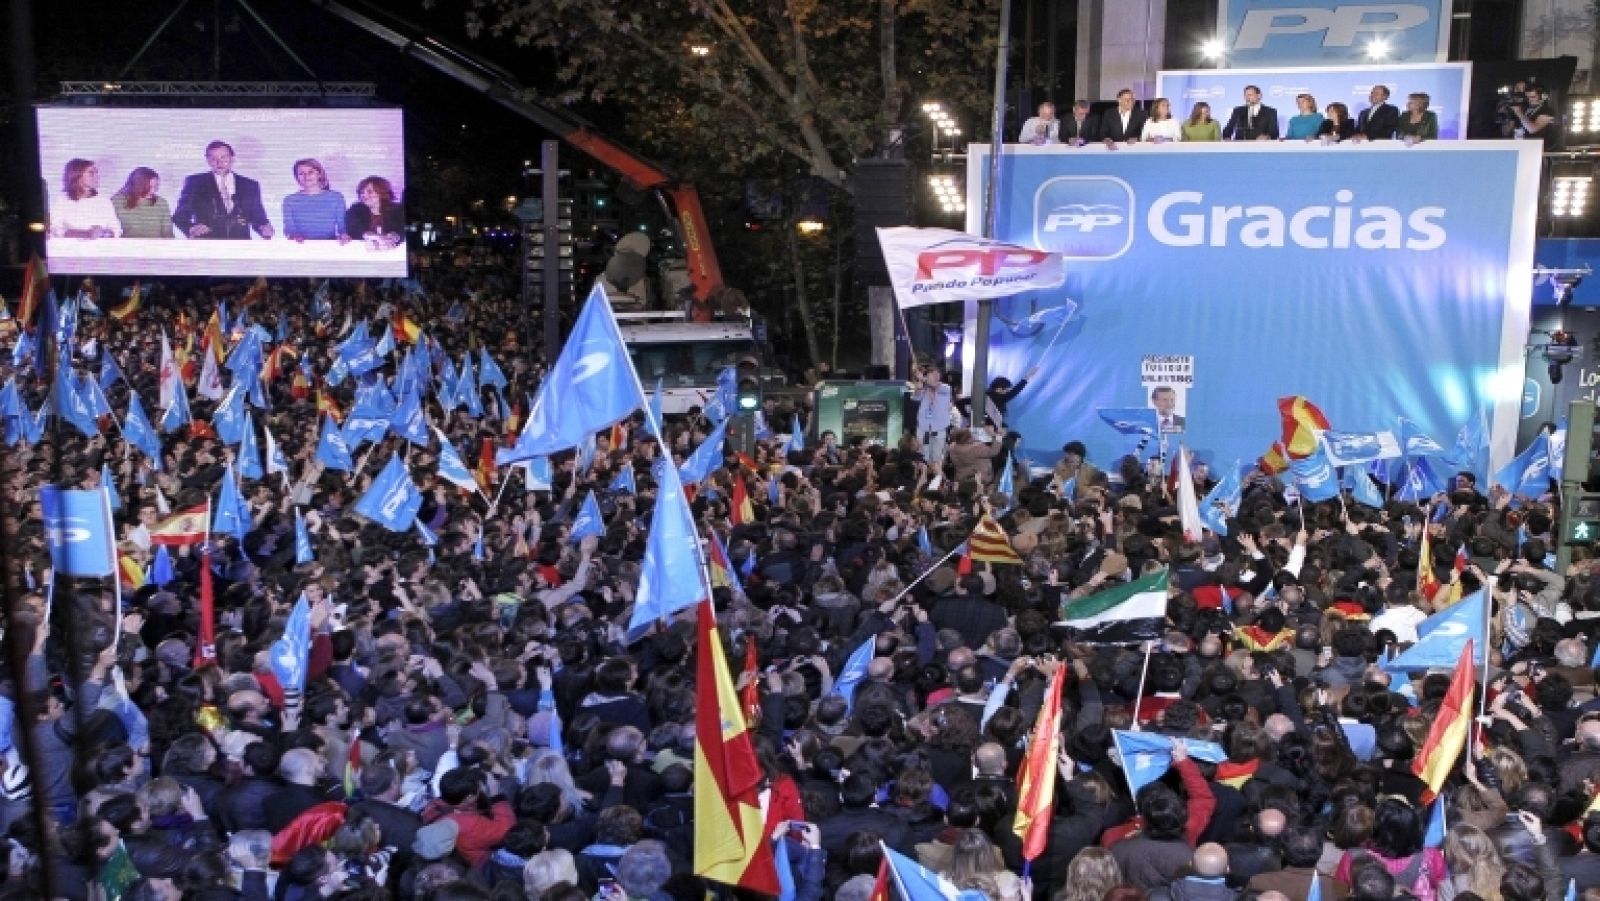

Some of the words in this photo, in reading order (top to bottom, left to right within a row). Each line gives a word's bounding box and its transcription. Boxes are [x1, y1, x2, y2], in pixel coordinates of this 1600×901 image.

[1232, 4, 1430, 50] PP
[1147, 188, 1447, 252] Gracias
[914, 248, 1049, 281] PP
